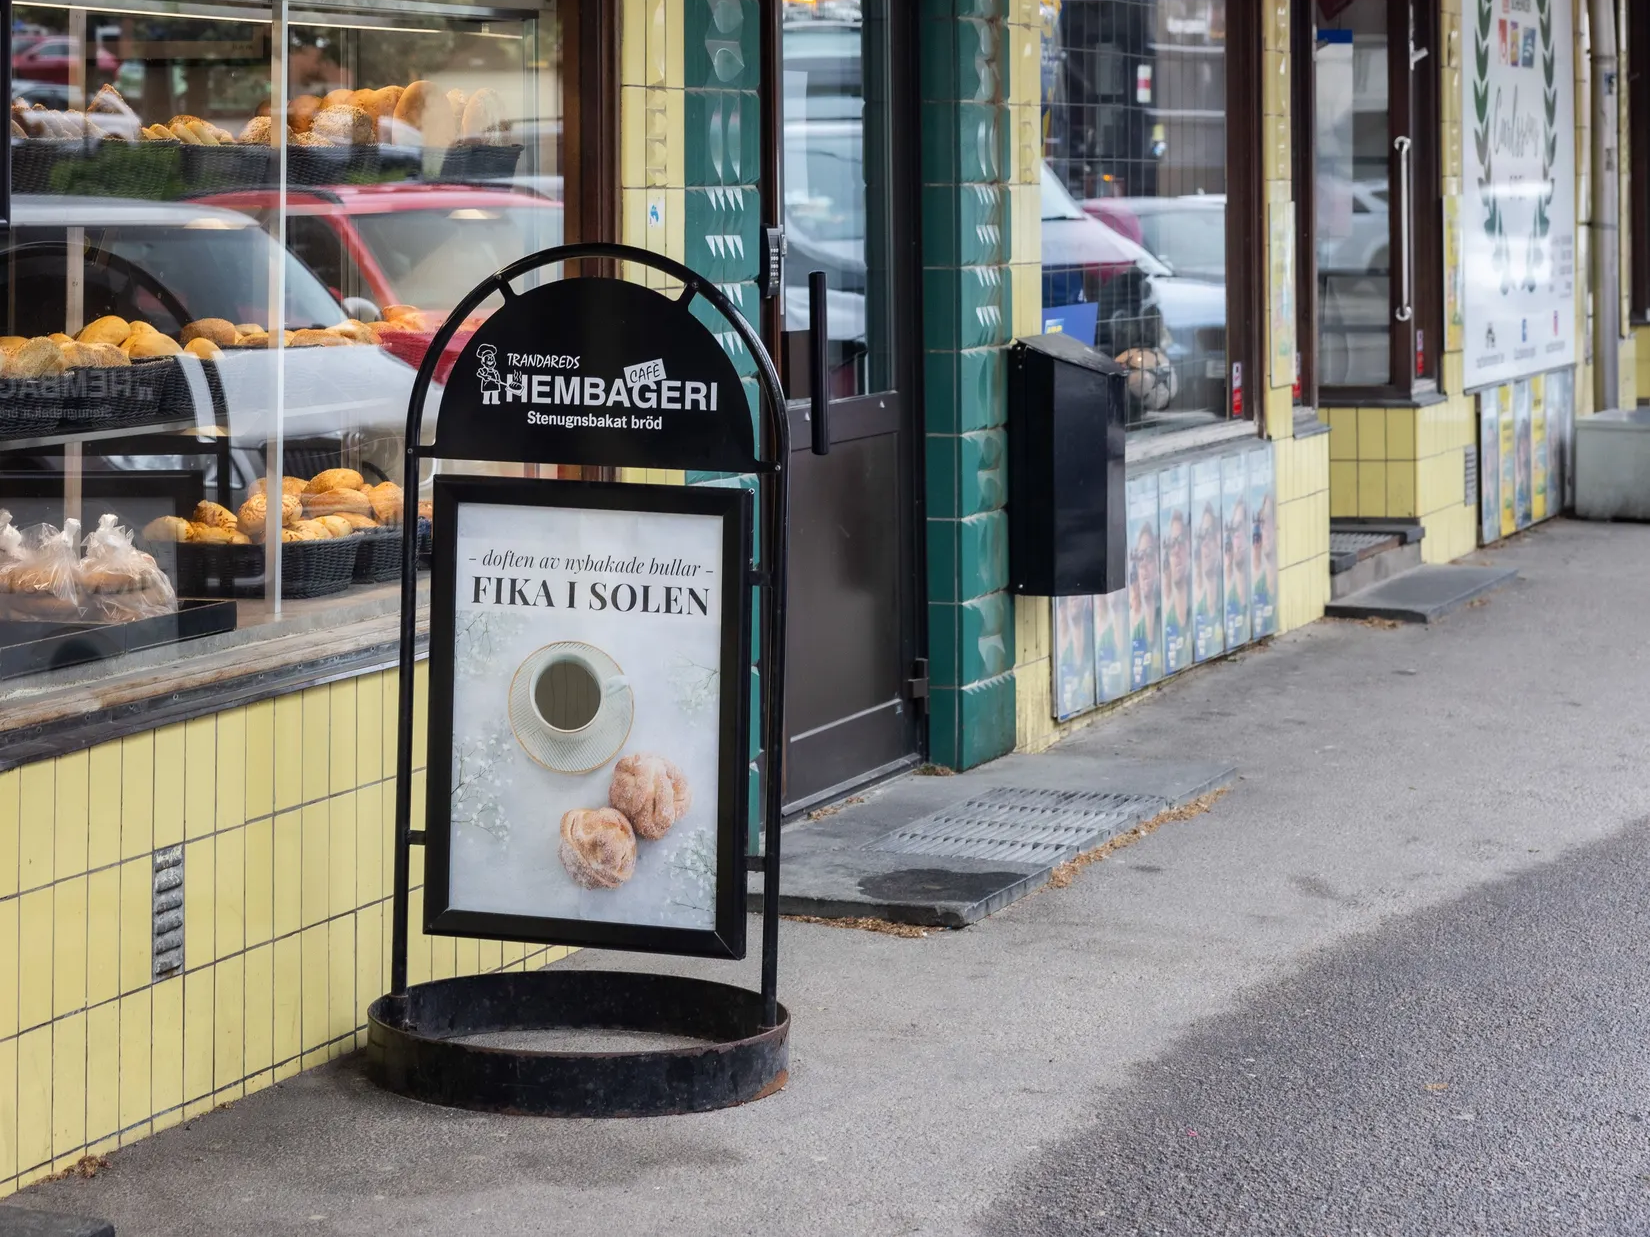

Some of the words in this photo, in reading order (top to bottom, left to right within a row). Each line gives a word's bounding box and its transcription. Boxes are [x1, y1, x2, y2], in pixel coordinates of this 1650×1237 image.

[507, 353, 580, 369] TRANDAREDS
[506, 372, 717, 411] HEMBAGERI
[527, 410, 627, 429] Stenugnsbakat
[631, 415, 662, 430] bröd
[482, 549, 534, 569] doften
[539, 555, 560, 569] av
[564, 554, 644, 575] nybakade
[648, 558, 701, 577] bullar
[471, 575, 556, 608] FIKA
[566, 581, 578, 609] I
[588, 581, 711, 616] SOLEN
